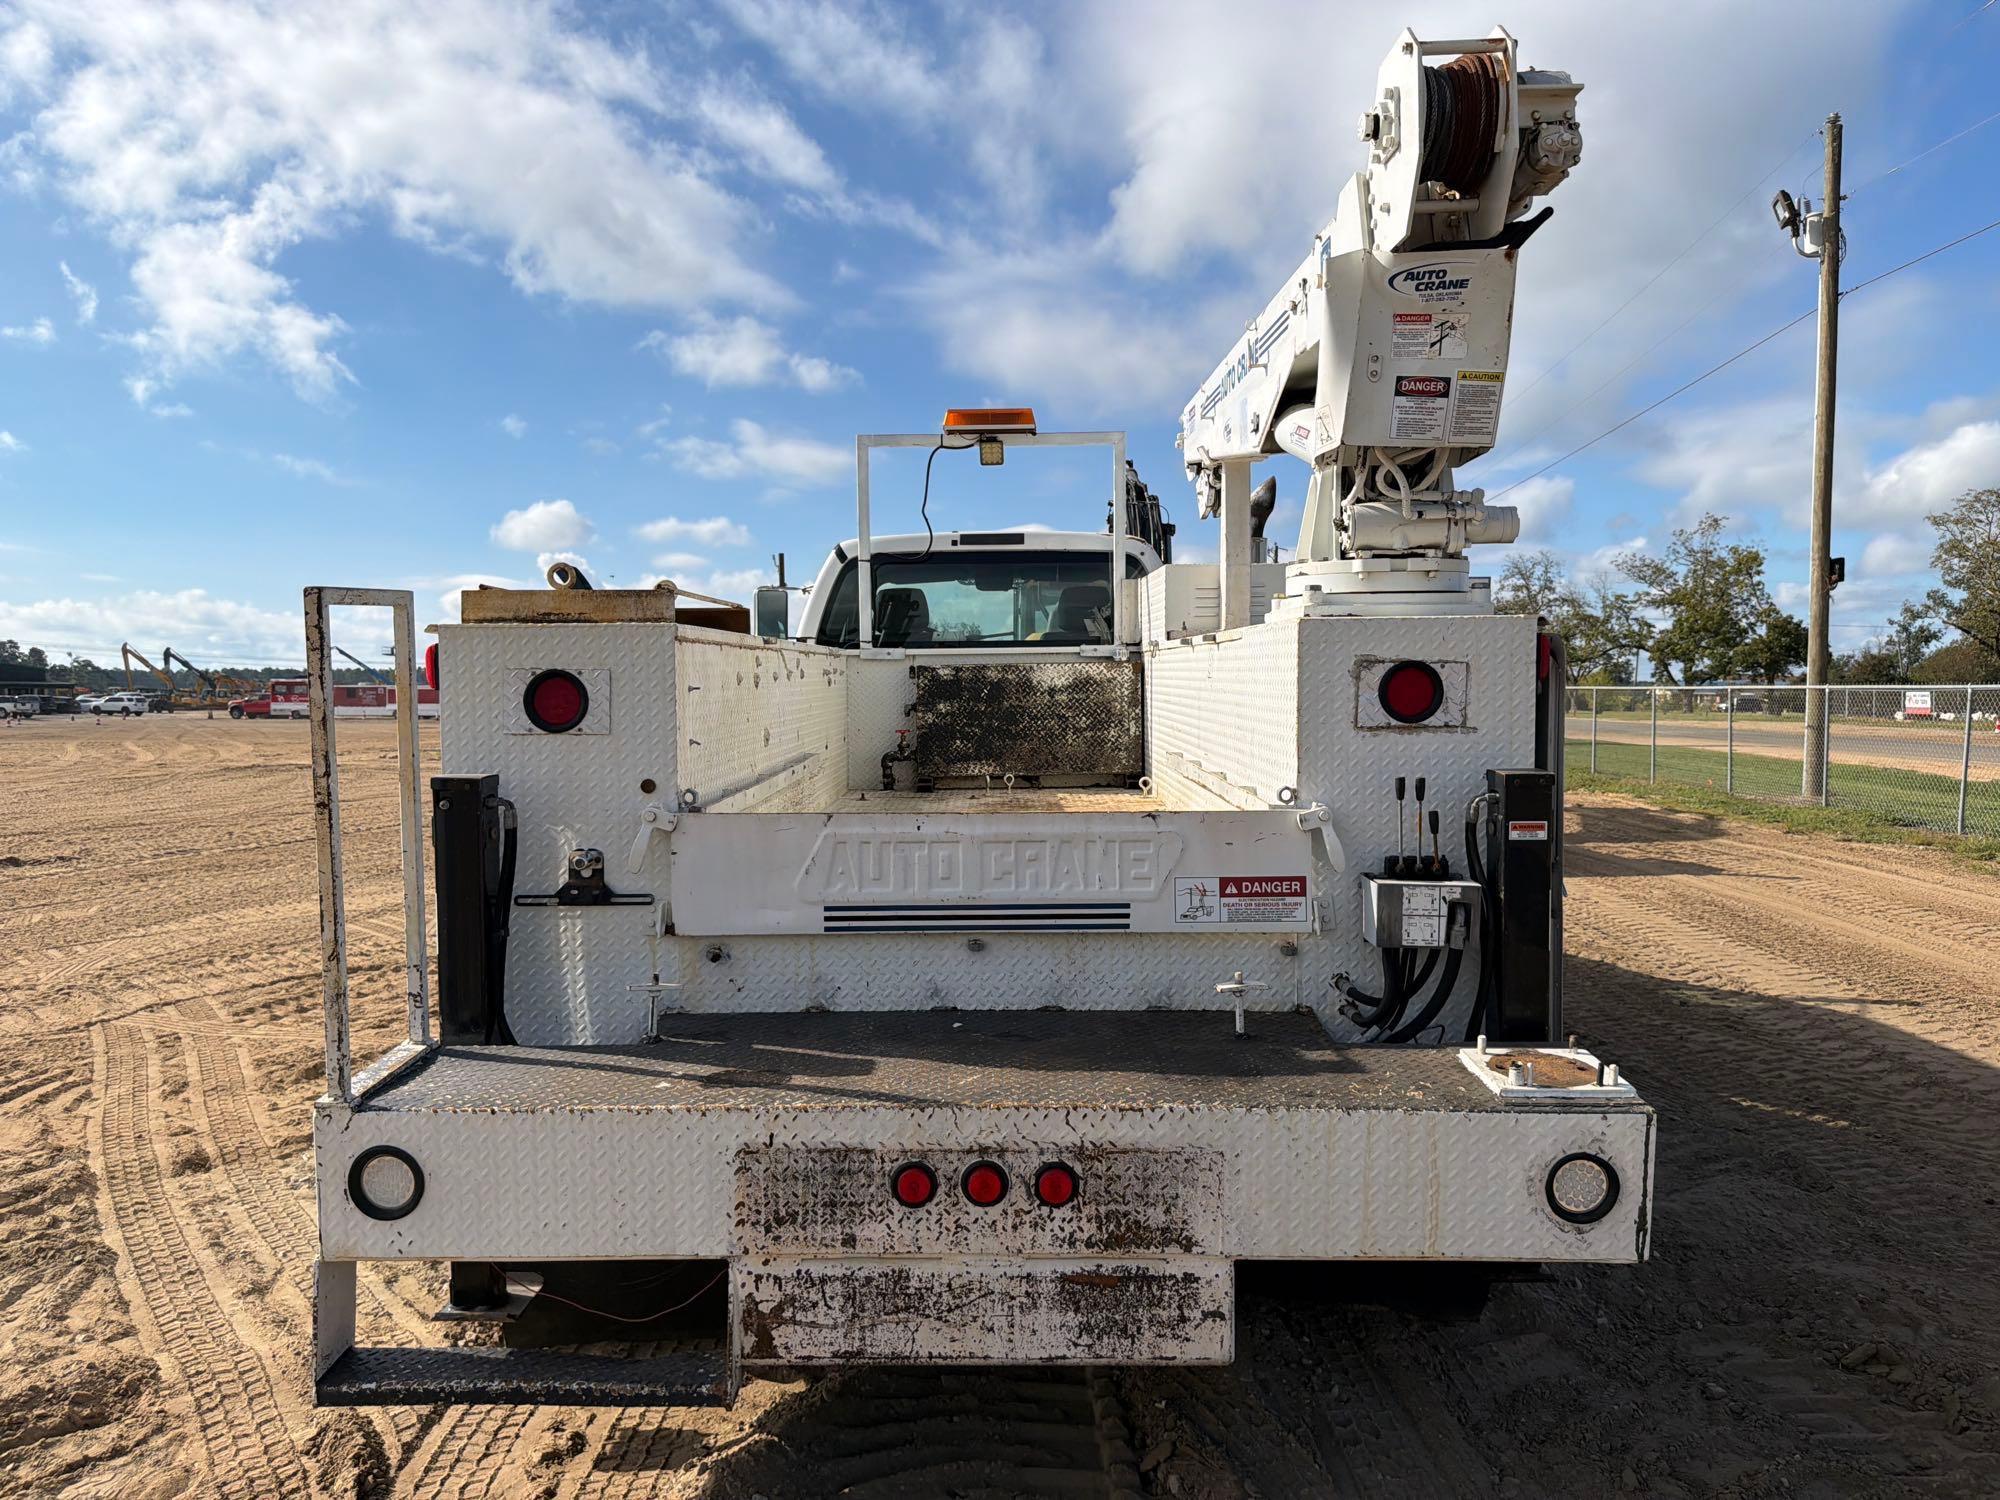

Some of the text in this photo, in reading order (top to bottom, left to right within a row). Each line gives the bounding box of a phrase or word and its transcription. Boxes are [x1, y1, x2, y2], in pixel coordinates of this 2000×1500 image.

[1402, 269, 1448, 282] AUTO
[1414, 279, 1470, 292] CRANE
[1220, 364, 1236, 402] AUTO
[1401, 381, 1445, 392] DANGER
[824, 839, 1156, 893] AUTO CRANE
[1242, 881, 1301, 893] DANGER
